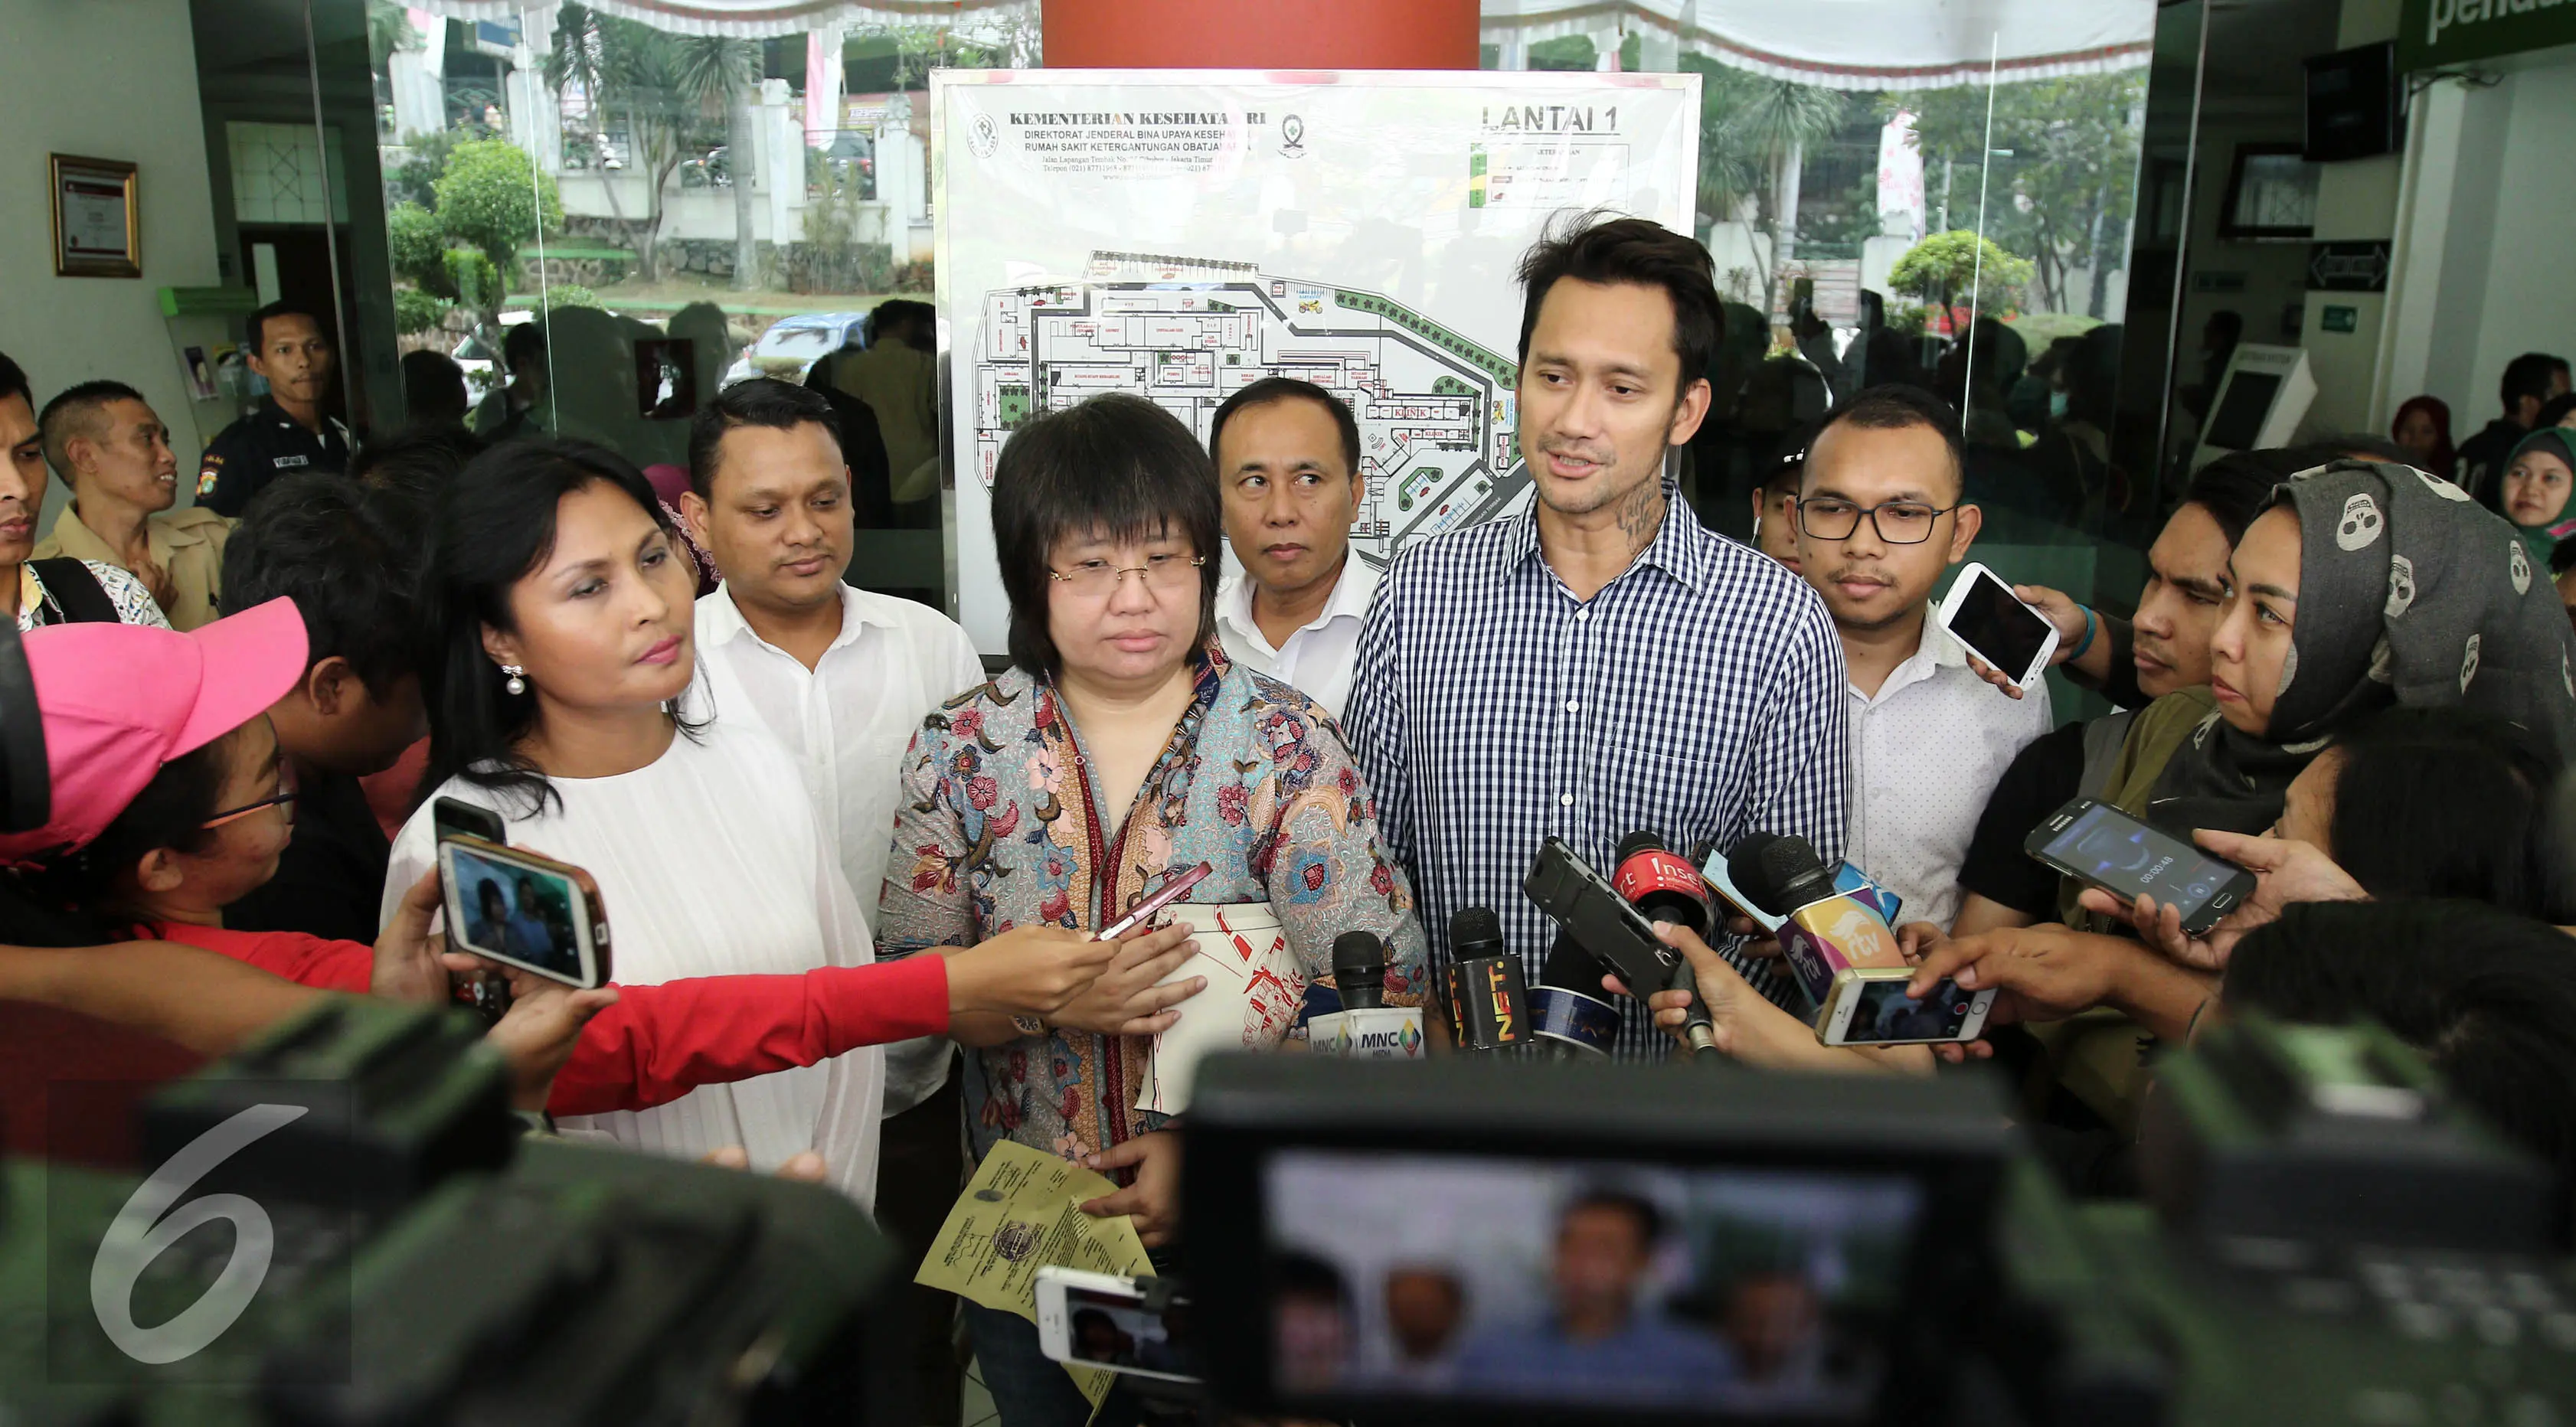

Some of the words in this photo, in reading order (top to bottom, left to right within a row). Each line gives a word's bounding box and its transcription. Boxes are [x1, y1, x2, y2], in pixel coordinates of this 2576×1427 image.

[1010, 113, 1135, 125] KEMENTERIAN
[1139, 113, 1230, 125] KESEHATA
[1247, 113, 1266, 125] RI
[1483, 106, 1593, 131] LANTAI
[1605, 106, 1617, 131] 1
[1025, 130, 1083, 139] DIREKTORAT
[1086, 130, 1135, 139] JENDERAL
[1137, 130, 1159, 139] BINA
[1162, 130, 1192, 139] UPAYA
[1025, 142, 1058, 152] RUMAH
[1061, 142, 1087, 152] SAKIT
[1090, 142, 1182, 152] KETERGANTUNGAN
[1059, 156, 1090, 165] Lapangan
[1395, 409, 1427, 417] KLINIK
[2140, 856, 2173, 883] 00:00:48
[1848, 931, 1881, 960] rtv
[1488, 961, 1515, 1041] NET.
[1362, 1032, 1399, 1048] MNC
